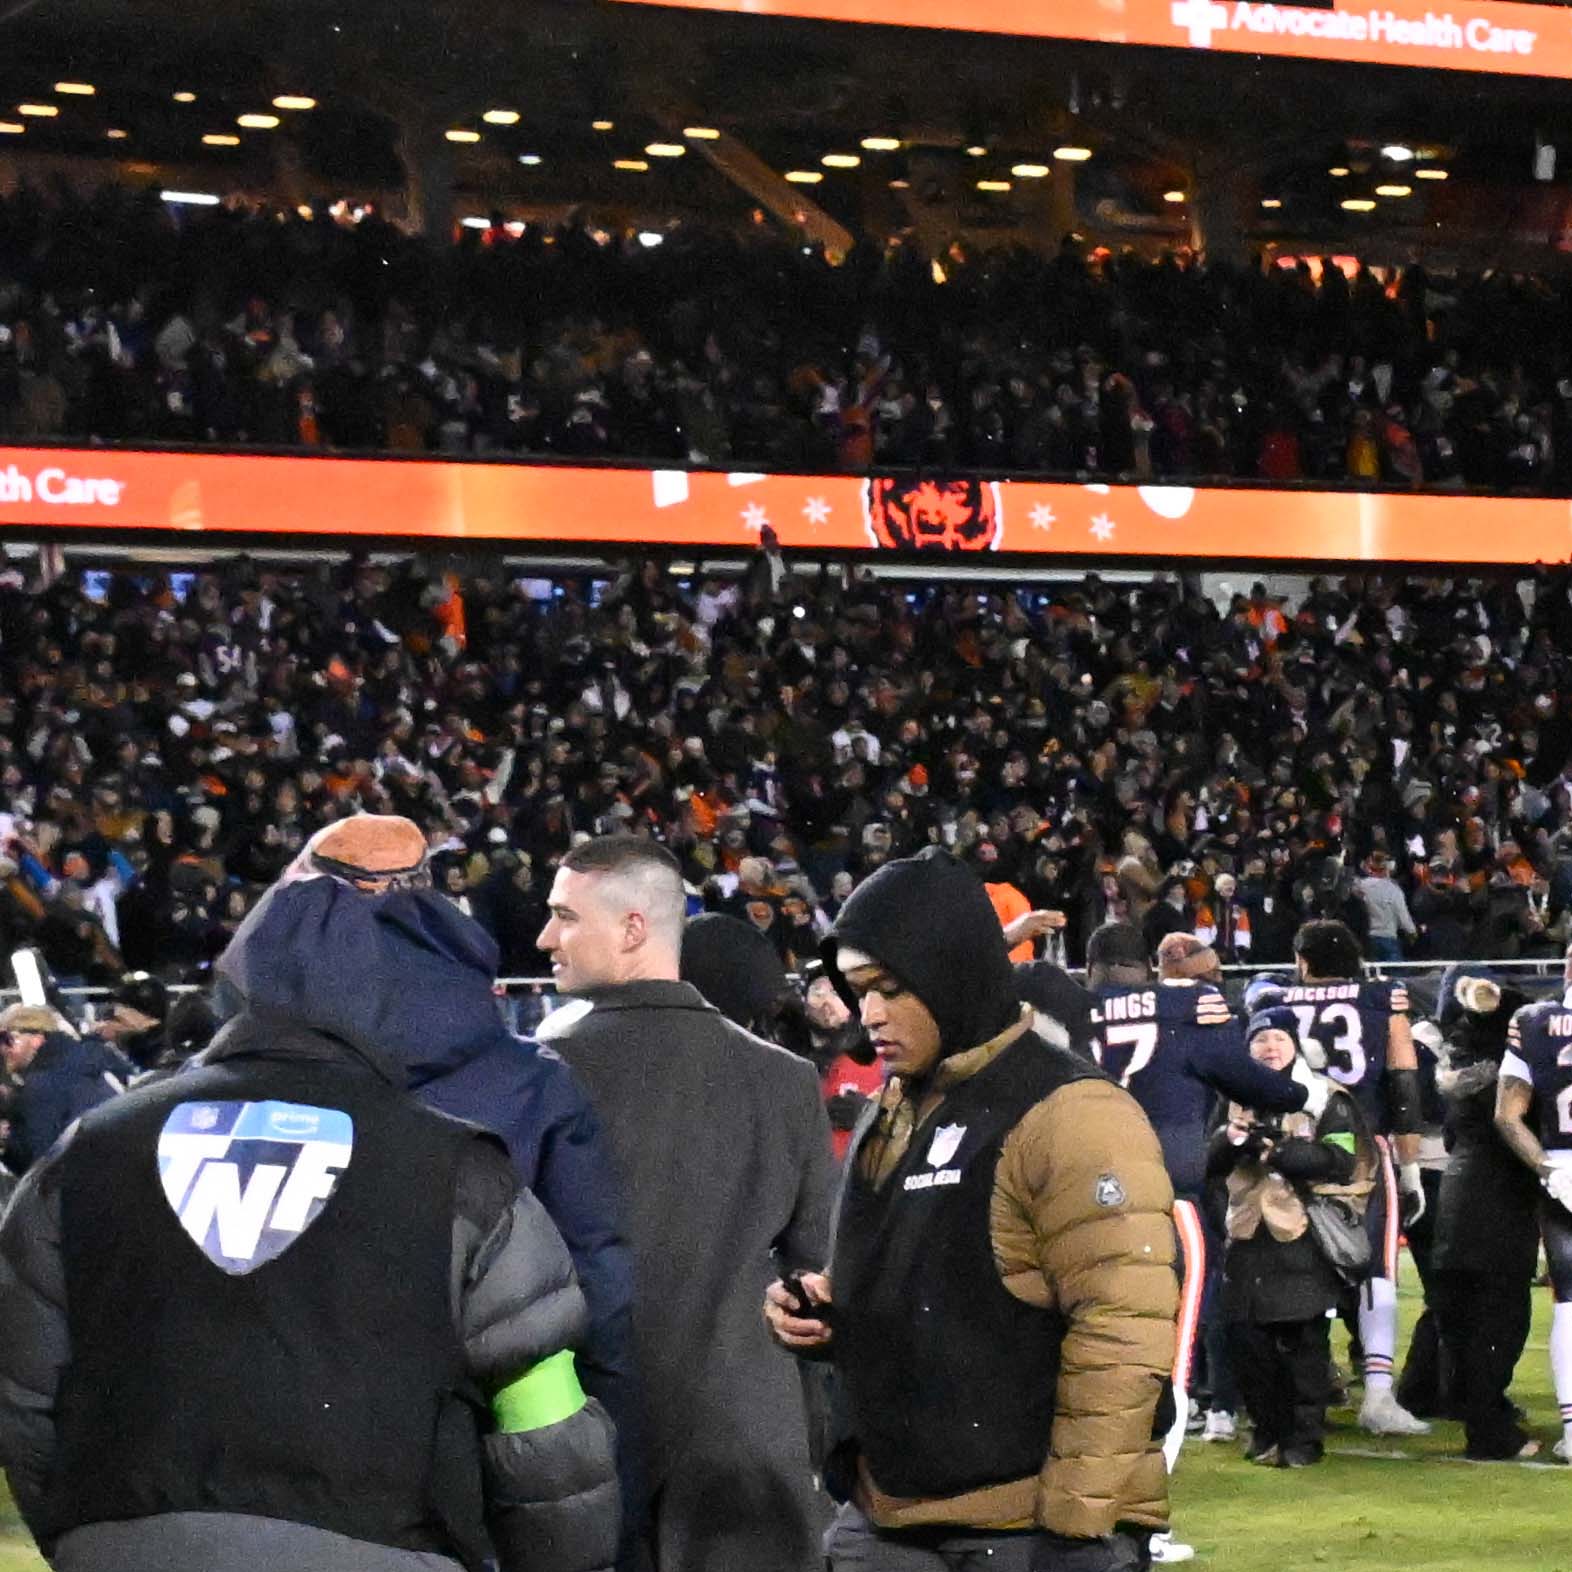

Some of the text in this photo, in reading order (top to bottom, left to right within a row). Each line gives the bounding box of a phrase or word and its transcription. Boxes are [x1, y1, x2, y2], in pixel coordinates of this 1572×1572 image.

[1230, 1, 1533, 54] Advocate Health Care
[35, 468, 120, 506] Care
[1282, 983, 1360, 1003] JACKSON
[270, 1111, 320, 1126] prime
[158, 1133, 353, 1260] TNF
